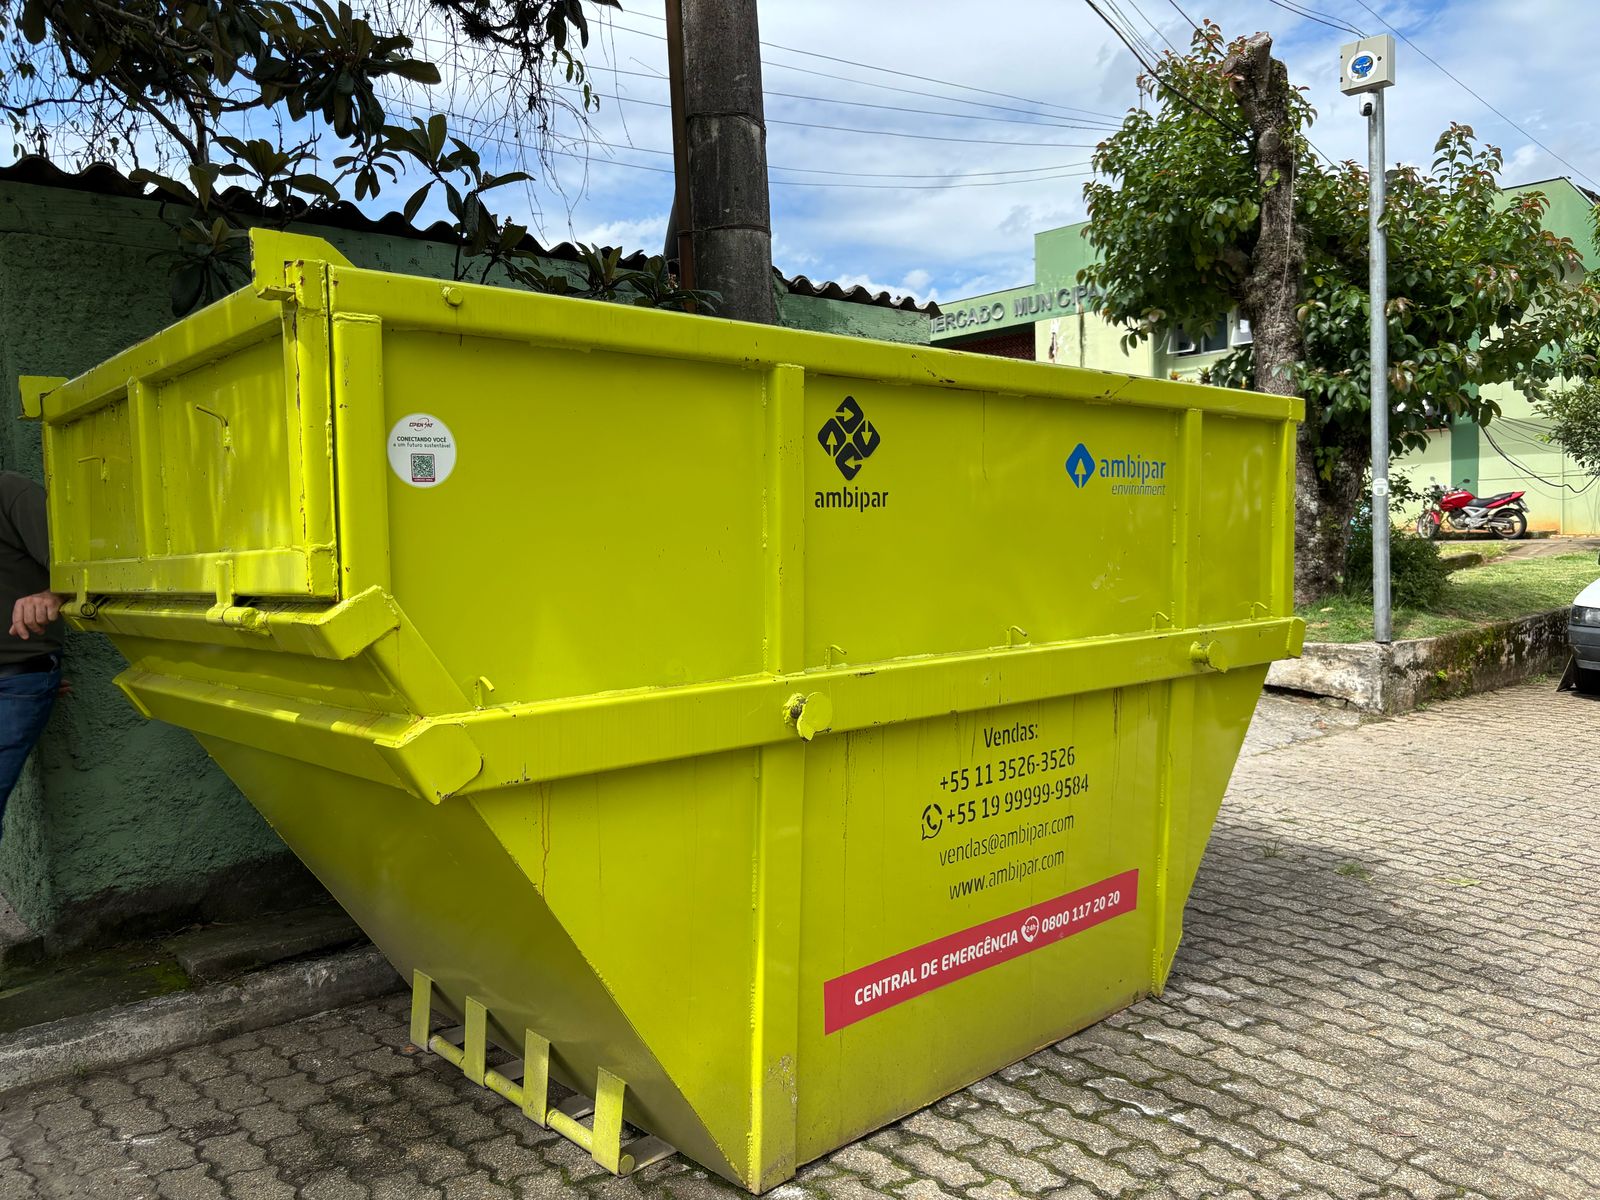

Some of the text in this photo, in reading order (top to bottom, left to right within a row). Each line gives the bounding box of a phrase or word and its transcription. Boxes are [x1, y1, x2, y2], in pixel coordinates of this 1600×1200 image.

[1100, 454, 1166, 484] ambipar
[1112, 481, 1166, 495] environment
[815, 486, 888, 512] ambipar
[984, 722, 1038, 748] Vendas:
[940, 746, 1075, 793] +55 11 3526-3526
[947, 773, 1089, 825] +55 19 99999-9584
[939, 814, 1074, 866] vendas@ambipar.com
[949, 850, 1064, 900] www.ambipar.com
[854, 967, 917, 1006] CENTRAL
[921, 958, 938, 979] DE
[941, 929, 1018, 972] EMERGÊNCIA
[1041, 910, 1069, 933] 0800
[1072, 903, 1091, 923] 117
[1094, 896, 1105, 913] 20
[1107, 890, 1120, 907] 20
